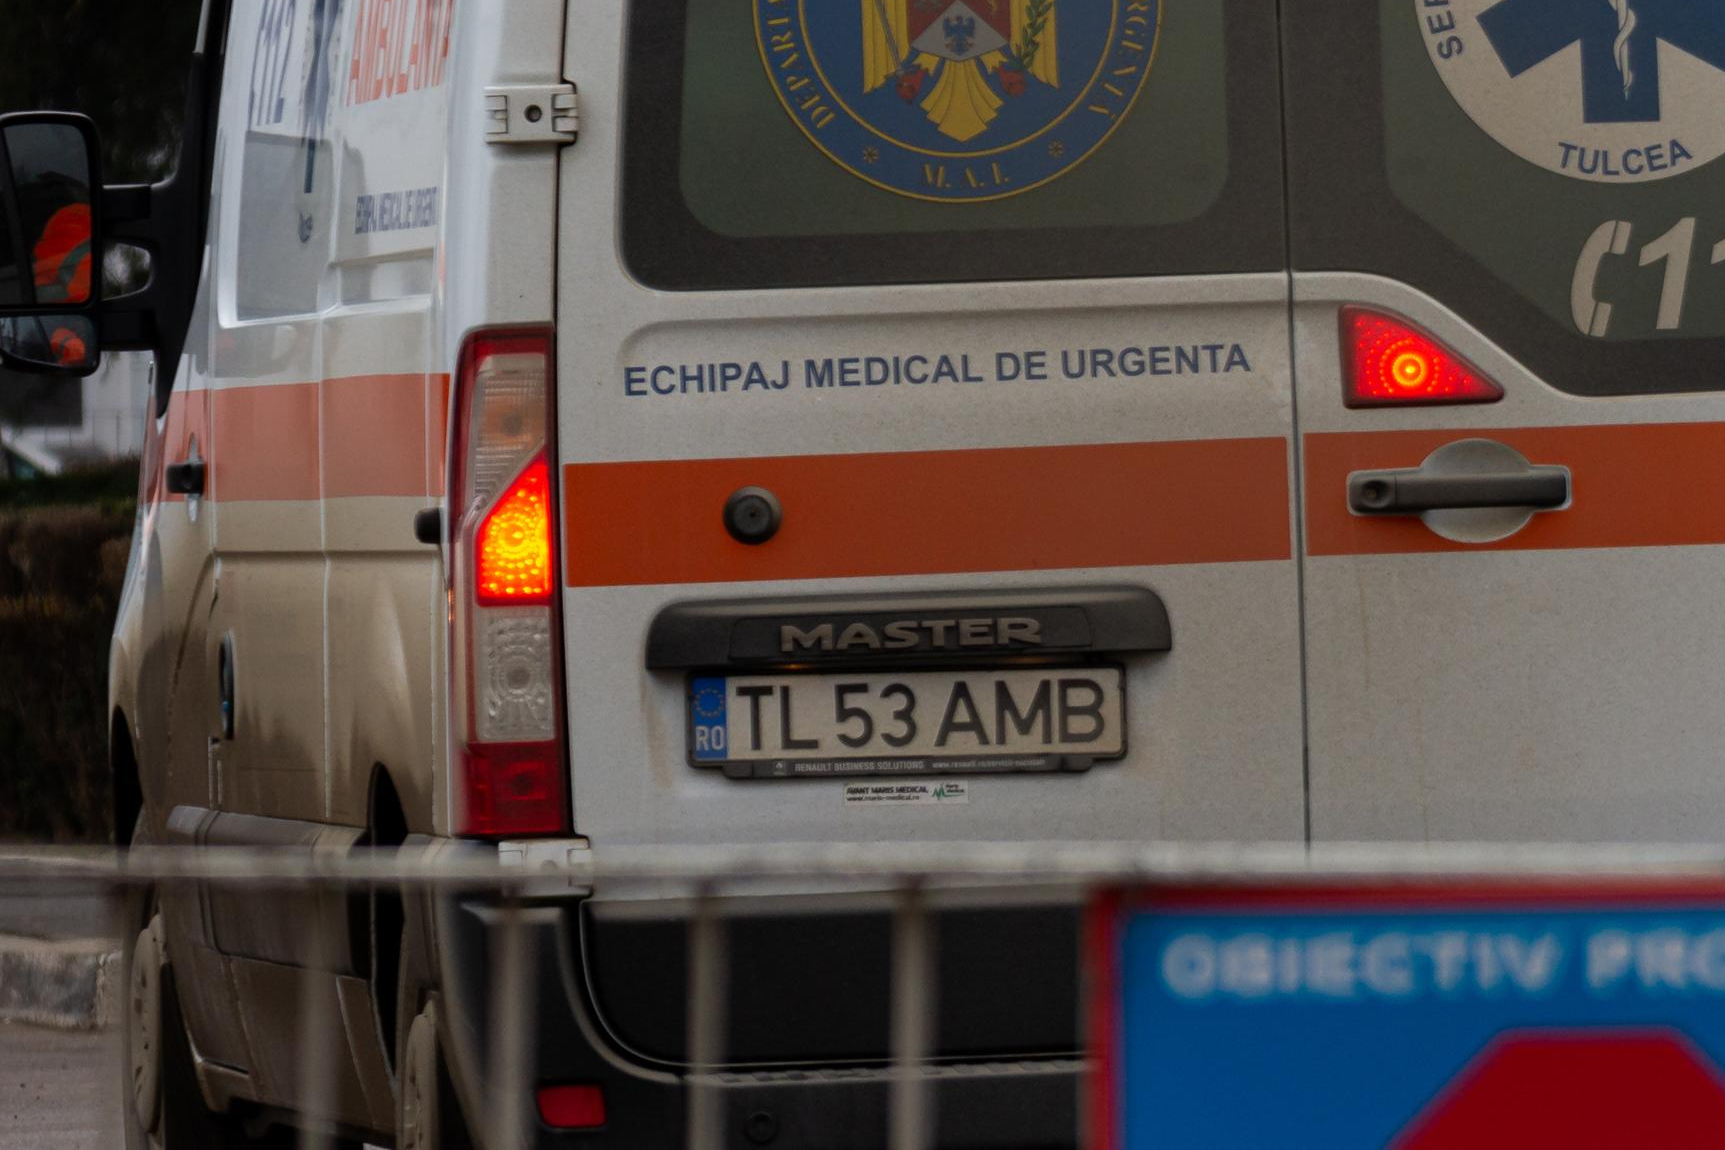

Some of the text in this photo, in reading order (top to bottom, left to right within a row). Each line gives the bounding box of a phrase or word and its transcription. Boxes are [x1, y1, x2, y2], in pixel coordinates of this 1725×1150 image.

[1557, 138, 1693, 176] TULCEA
[623, 343, 1252, 397] ECHIPAJ MEDICAL DE URGENTA
[780, 617, 1042, 653] MASTER
[735, 678, 1106, 751] TL 53 AMB
[696, 726, 724, 749] RO
[794, 759, 924, 772] RENAULT BUSINESS SOLUTIONS
[1161, 931, 1564, 998] OBIECTIV
